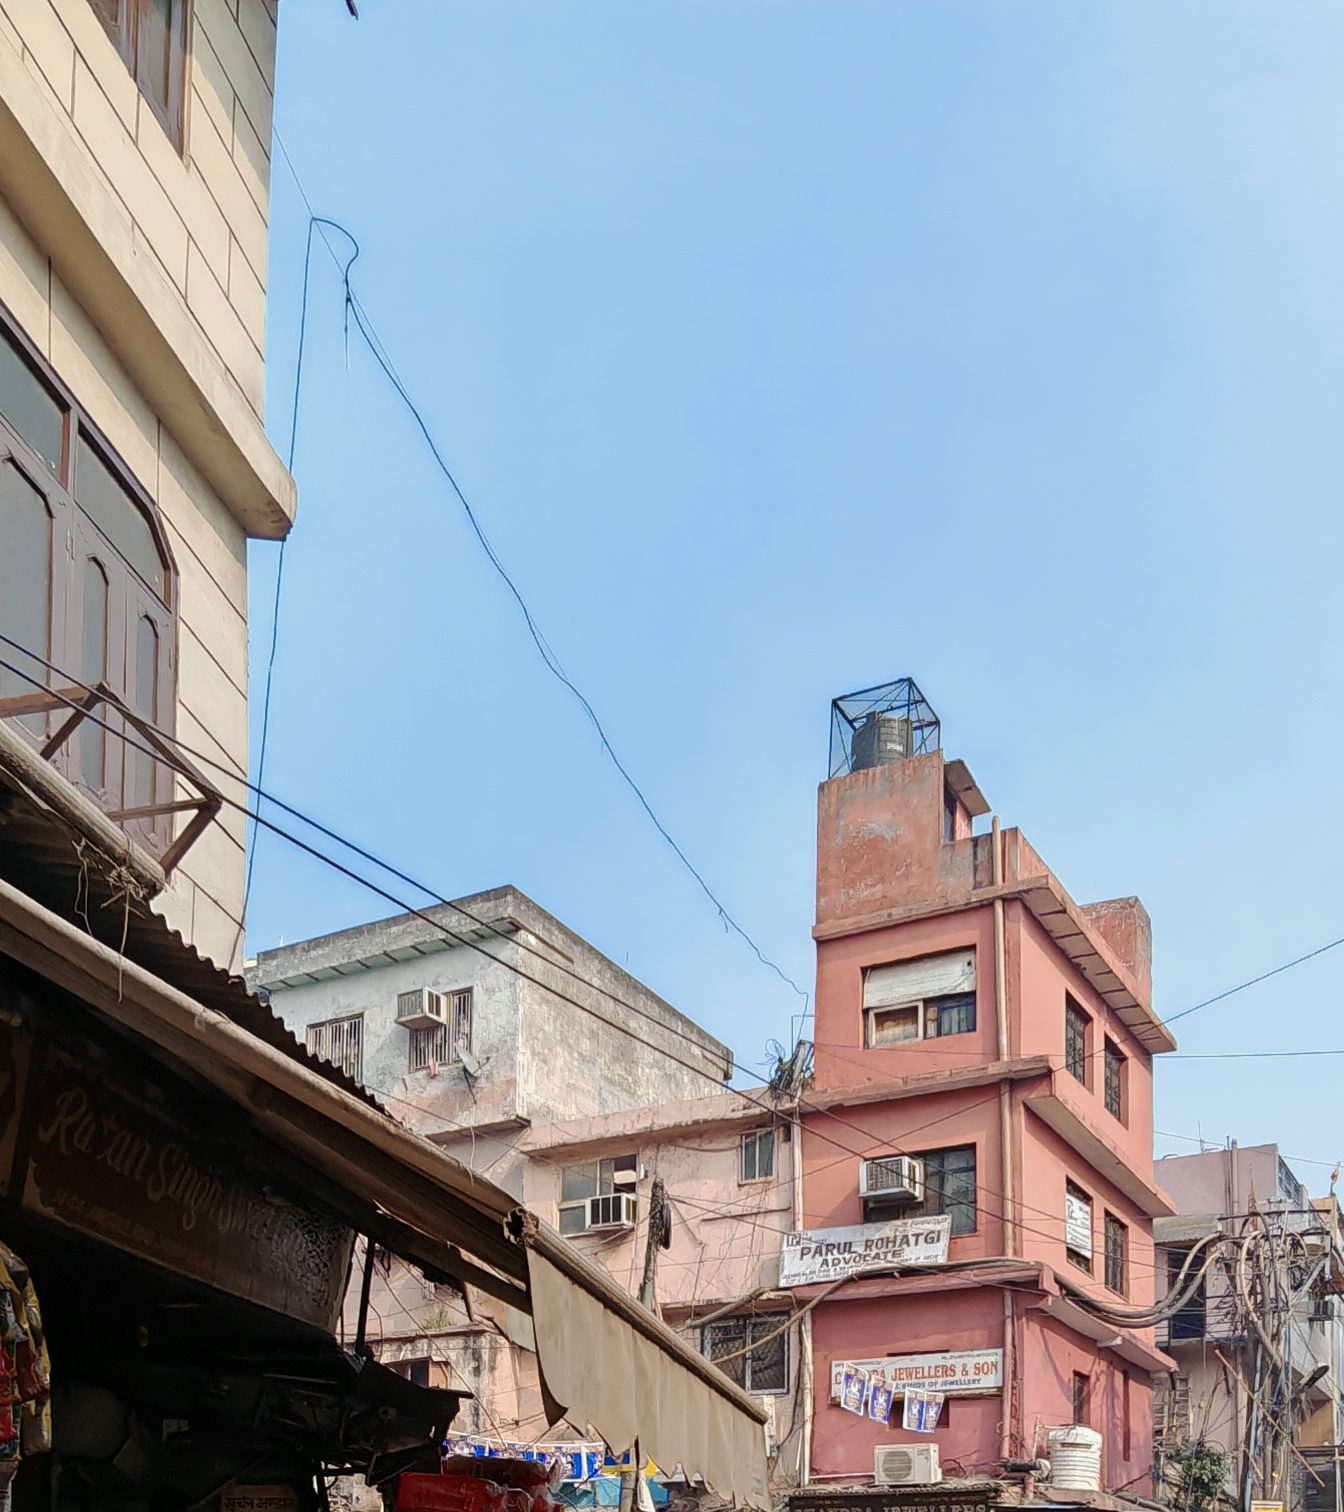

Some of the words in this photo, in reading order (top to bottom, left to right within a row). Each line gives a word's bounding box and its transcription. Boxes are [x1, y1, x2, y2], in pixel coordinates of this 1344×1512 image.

[800, 1241, 857, 1261] PARUL
[864, 1230, 941, 1252] ROHATGI
[820, 1250, 902, 1268] ADVOCATE
[891, 1363, 956, 1382] JEWELLERS
[961, 1364, 969, 1377] &
[973, 1361, 998, 1376] SON
